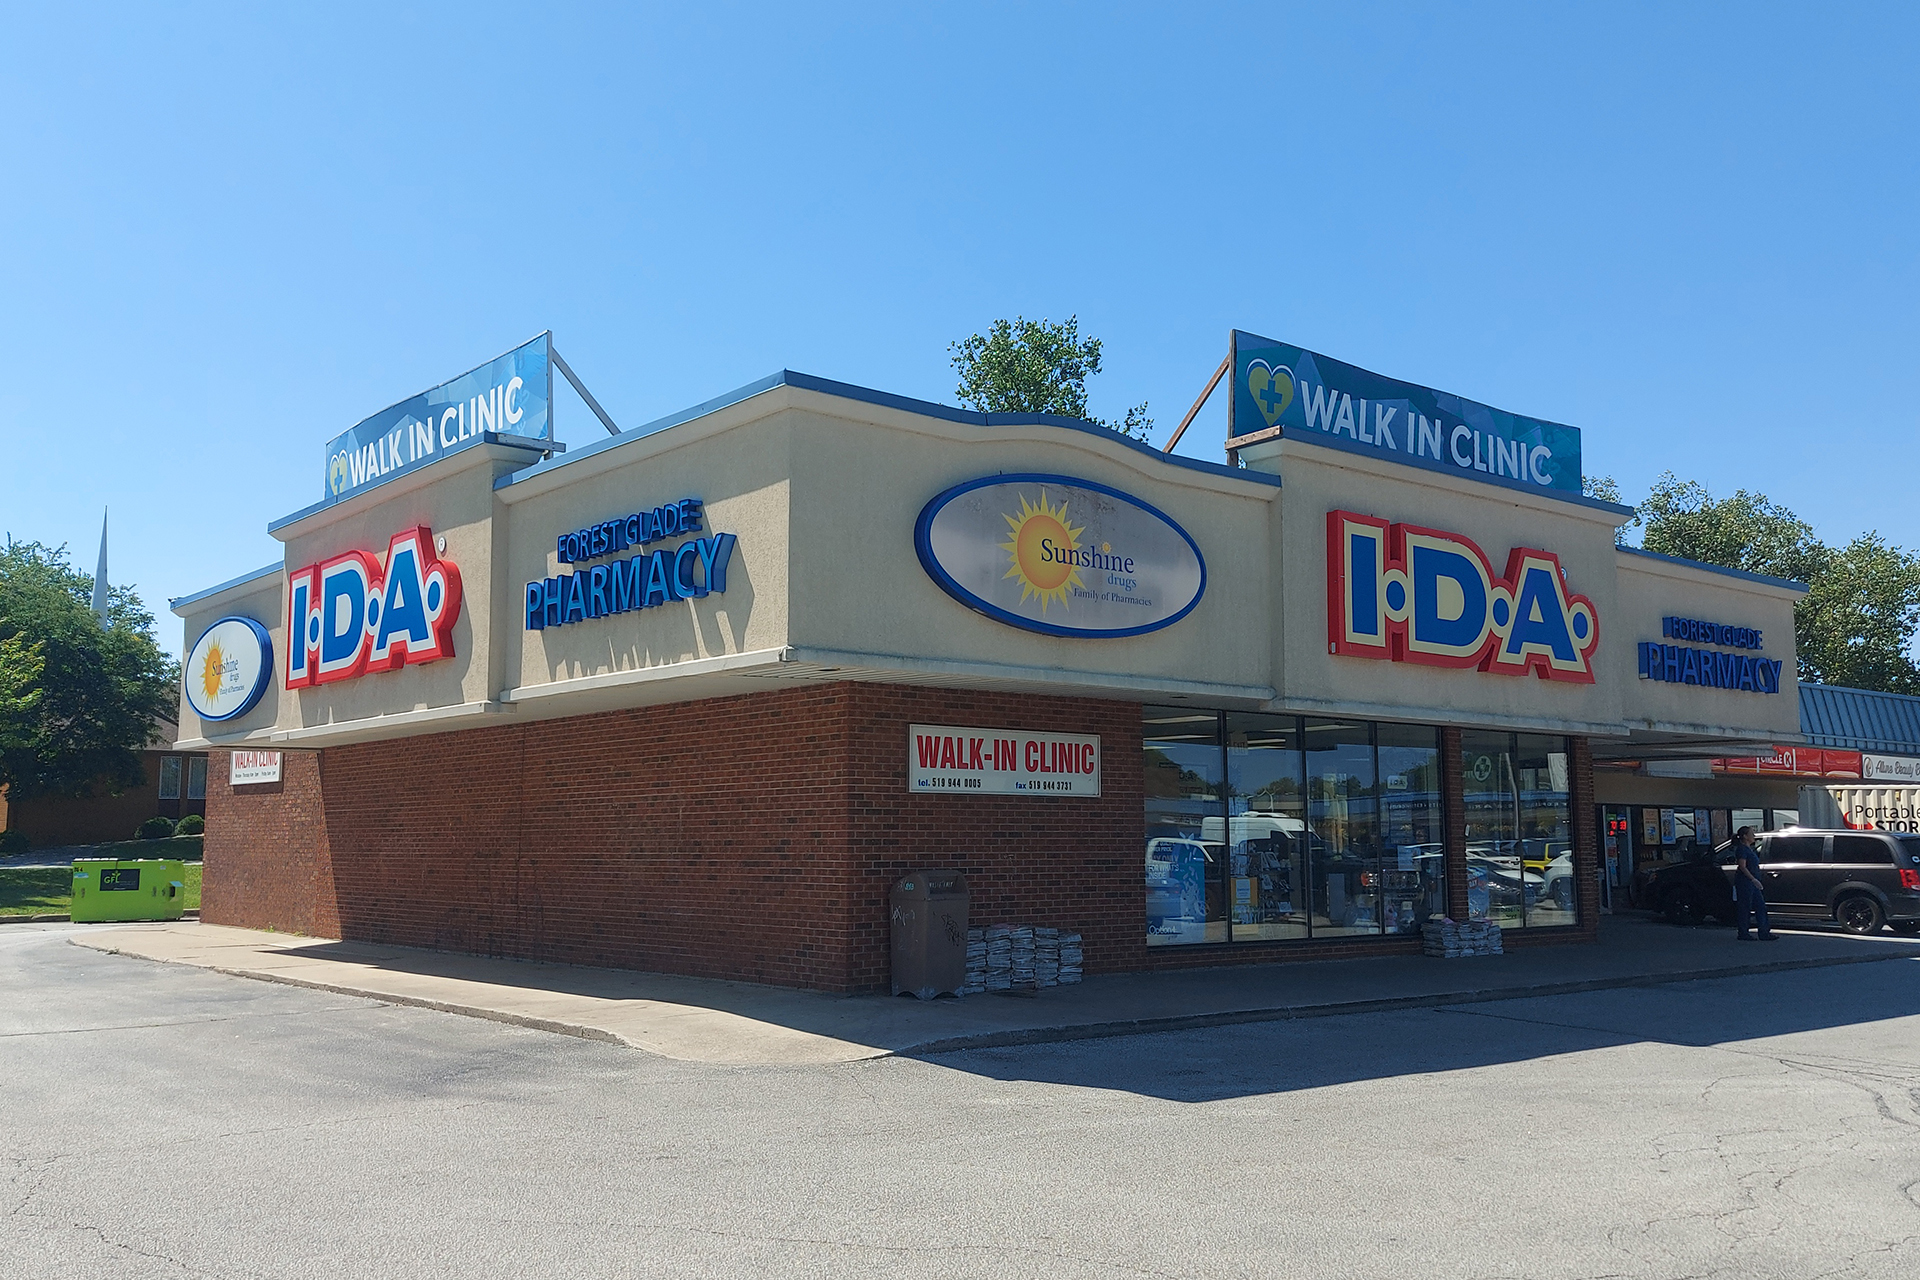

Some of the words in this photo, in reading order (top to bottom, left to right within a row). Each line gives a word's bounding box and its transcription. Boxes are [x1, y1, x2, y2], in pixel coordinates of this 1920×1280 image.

[349, 428, 403, 487] WALK
[409, 416, 434, 462] IN
[439, 376, 524, 448] CLINIC
[1301, 380, 1397, 450] WALK
[1407, 412, 1441, 460] IN
[1450, 425, 1553, 485] CLINIC
[557, 519, 626, 563] FOREST
[625, 499, 703, 545] GLADE
[1041, 538, 1135, 574] Sunshine
[526, 532, 737, 630] PHARMACY
[1073, 587, 1100, 604] Family
[1101, 592, 1110, 601] of
[1111, 593, 1153, 607] Pharmacies
[1107, 573, 1137, 591] drugs
[1666, 616, 1720, 645] FOREST
[1722, 625, 1763, 650] GLADE
[1640, 642, 1783, 694] PHARMACY
[917, 735, 1017, 771] WALK-IN
[1025, 740, 1095, 774] CLINIC
[1895, 761, 1914, 778] Beauty
[932, 778, 945, 787] 519
[948, 778, 961, 788] 944
[1015, 781, 1027, 790] fax
[1029, 780, 1041, 790] 519
[1043, 781, 1055, 790] 944
[1056, 781, 1072, 791] 3731
[104, 871, 121, 884] GFL
